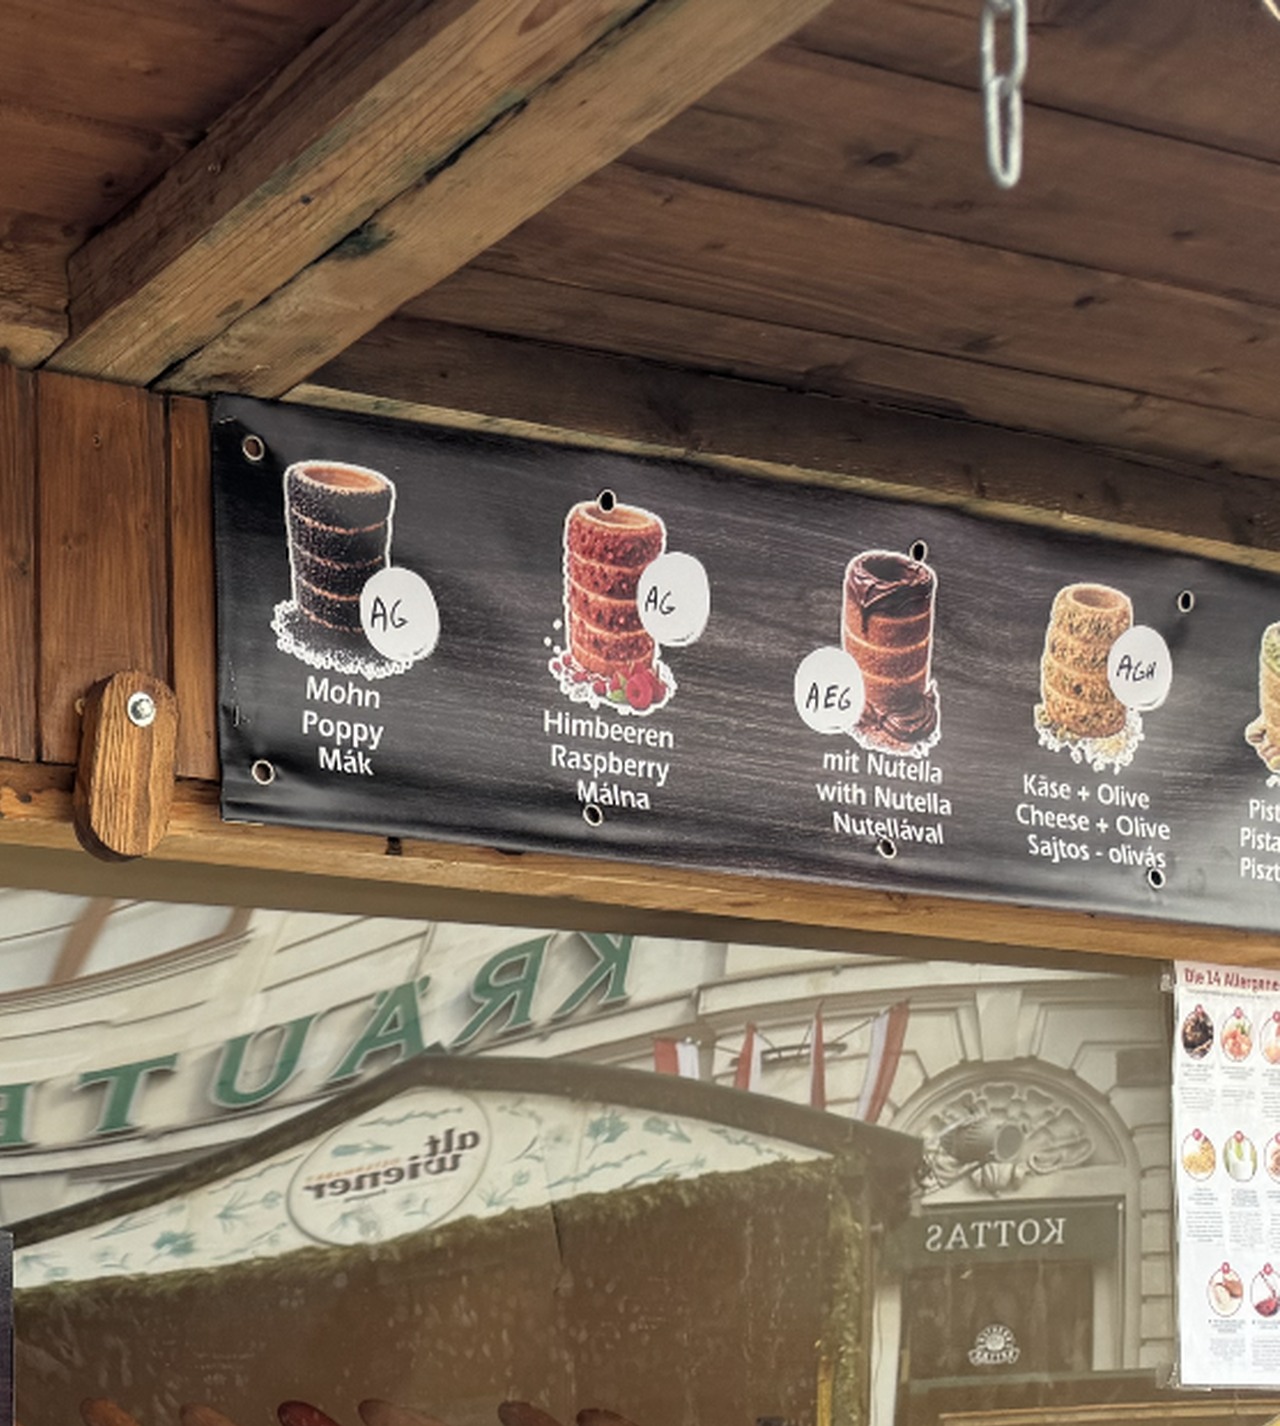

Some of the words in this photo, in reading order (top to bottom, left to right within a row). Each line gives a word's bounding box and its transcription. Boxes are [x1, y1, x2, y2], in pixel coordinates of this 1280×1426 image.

[369, 597, 409, 632] AG
[644, 586, 676, 616] AG
[306, 677, 381, 709] Mohn
[805, 684, 851, 712] AEG
[302, 711, 384, 749] Poppy
[543, 710, 675, 749] Himbeeren
[319, 747, 374, 776] Mák
[551, 745, 670, 786] Raspberry
[823, 750, 861, 773] mit
[866, 755, 943, 784] Nutella
[577, 780, 651, 810] Málna
[816, 780, 867, 806] with
[874, 787, 952, 816] Nutella
[1023, 774, 1072, 801] Käse
[1077, 787, 1091, 802] +
[1097, 783, 1151, 810] Olive
[833, 811, 944, 845] Nutellával
[1016, 804, 1090, 832] Cheese
[1096, 818, 1109, 833] +
[1115, 816, 1171, 841] Olive
[1028, 835, 1090, 864] Sajtos
[1108, 846, 1167, 870] olivás
